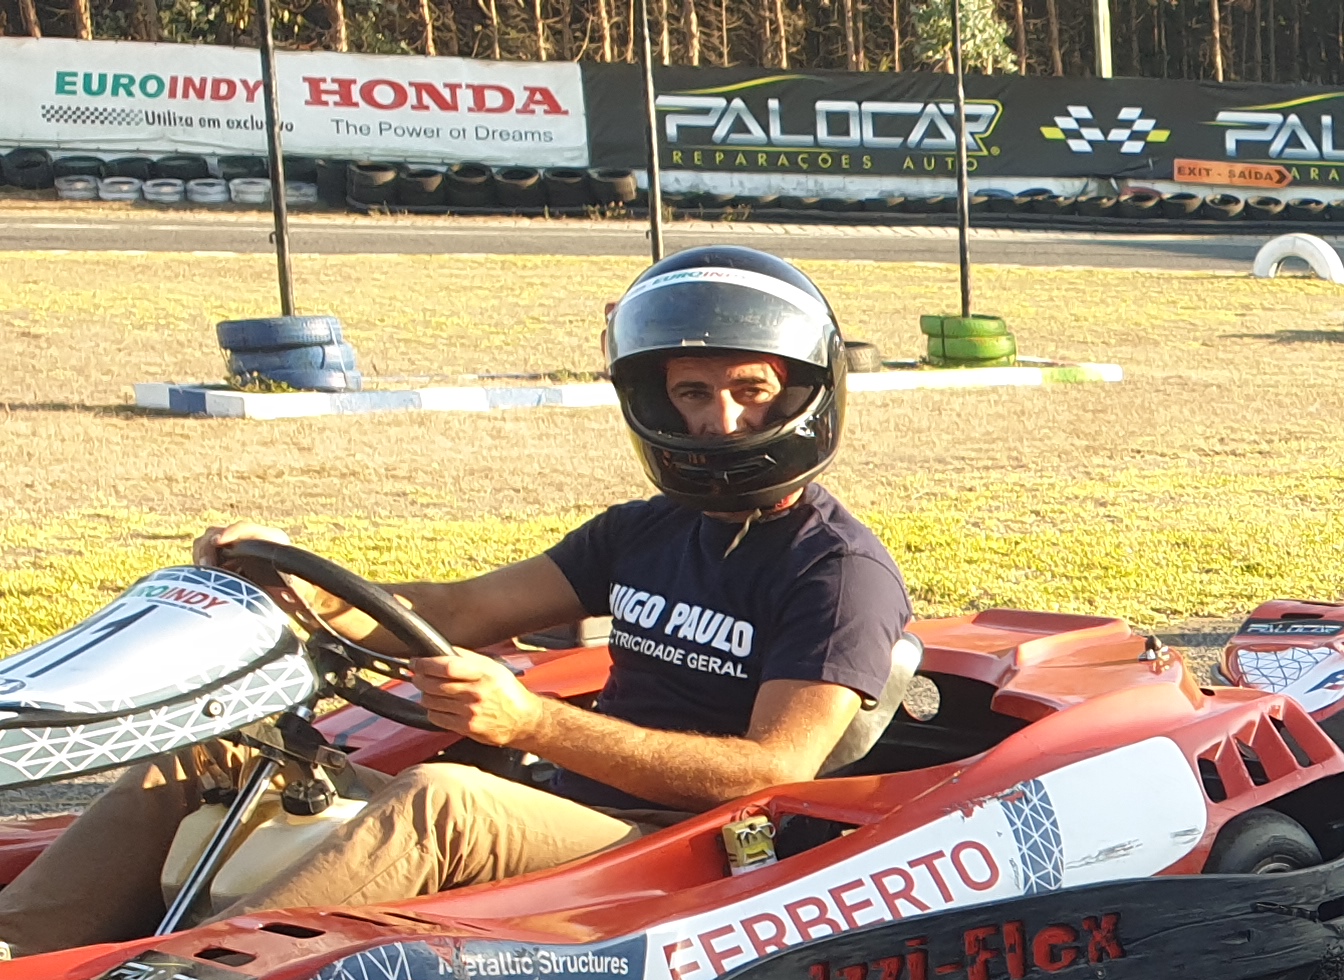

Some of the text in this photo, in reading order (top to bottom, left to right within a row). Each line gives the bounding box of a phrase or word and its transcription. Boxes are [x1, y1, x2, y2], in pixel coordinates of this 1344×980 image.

[55, 71, 264, 103] EUROINDY
[302, 76, 570, 116] HONDA
[145, 110, 194, 128] Utiliza
[226, 115, 294, 132] excluvo
[331, 118, 554, 143] The Power of Dreams
[656, 94, 998, 151] PALOCAR
[672, 150, 978, 172] REPARAÇÕES AUTO
[1176, 164, 1211, 179] EXIT
[1228, 165, 1274, 183] SAÍDA
[664, 602, 756, 658] PAULO
[610, 629, 749, 679] CTRICIDADE GERAL
[537, 949, 629, 976] Structures
